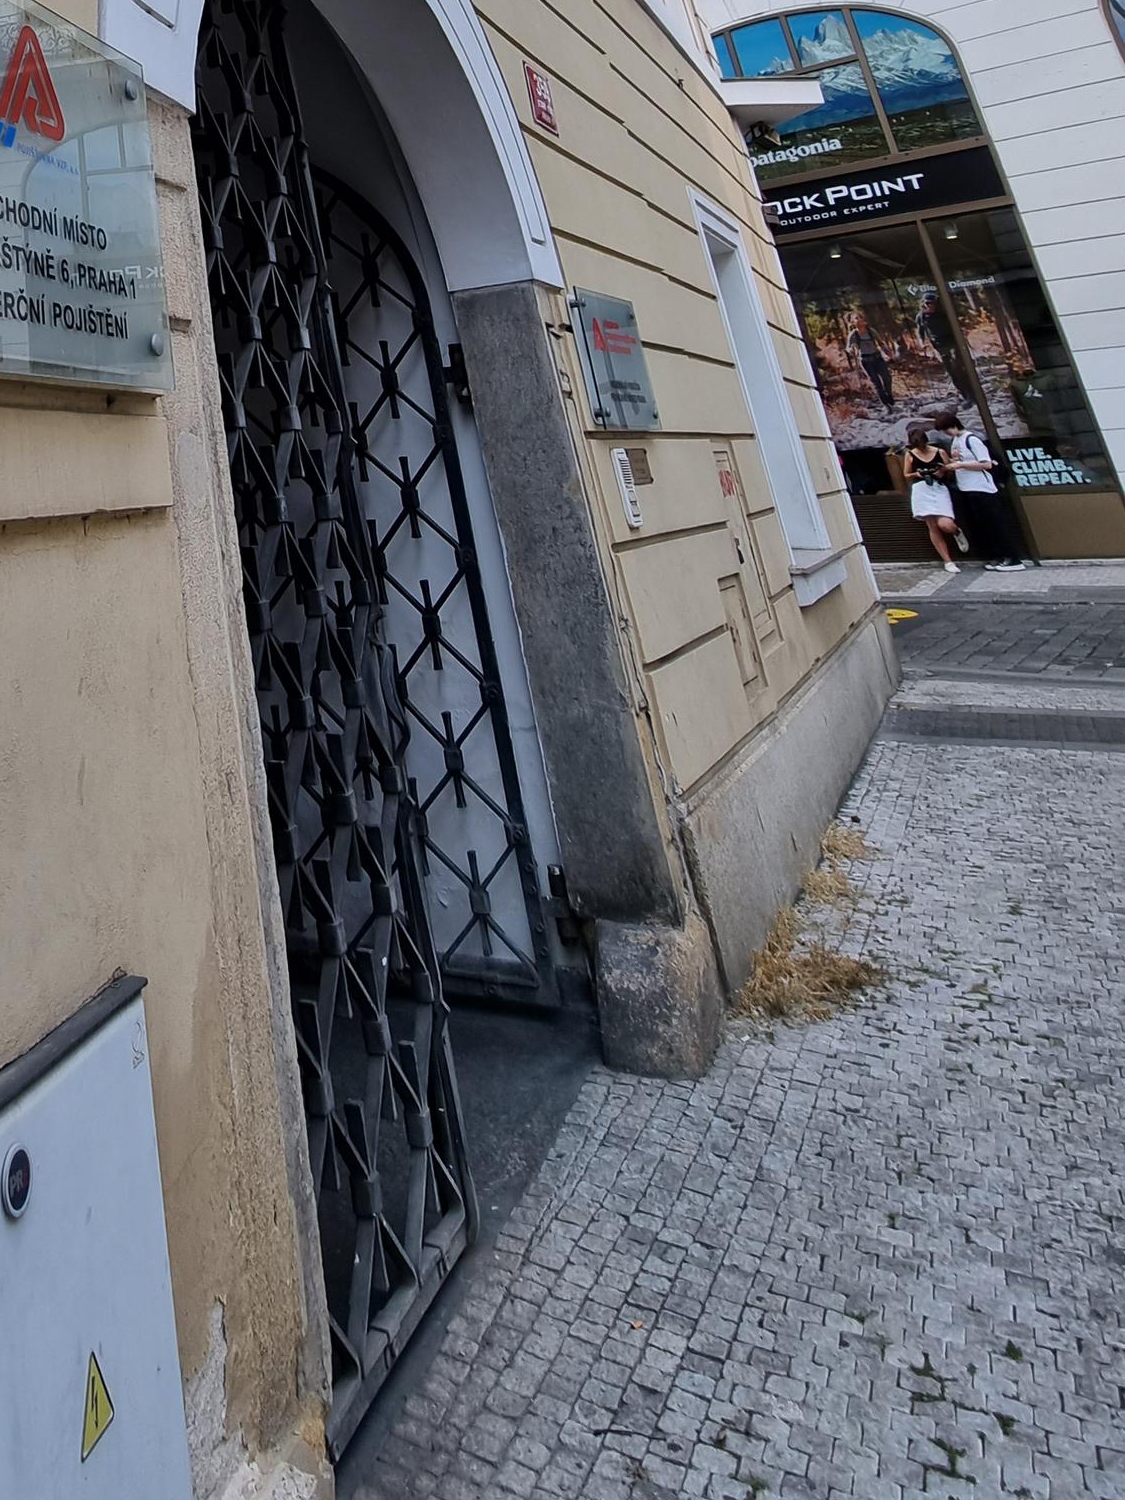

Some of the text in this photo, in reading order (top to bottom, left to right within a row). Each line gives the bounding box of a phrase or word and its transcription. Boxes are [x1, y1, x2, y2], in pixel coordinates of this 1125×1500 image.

[762, 193, 824, 215] OCK
[780, 201, 890, 227] OUTDOOR EXPERT
[63, 213, 107, 250] MÍSTO
[61, 259, 74, 289] 6,
[78, 264, 128, 298] PRAHA
[130, 277, 136, 299] 1
[948, 276, 995, 289] Diamond
[52, 302, 129, 339] POJIŠTĚNÍ
[1006, 447, 1052, 462] LIVE.
[1012, 459, 1073, 474] CLIMB.
[1016, 470, 1092, 487] REPEAT.
